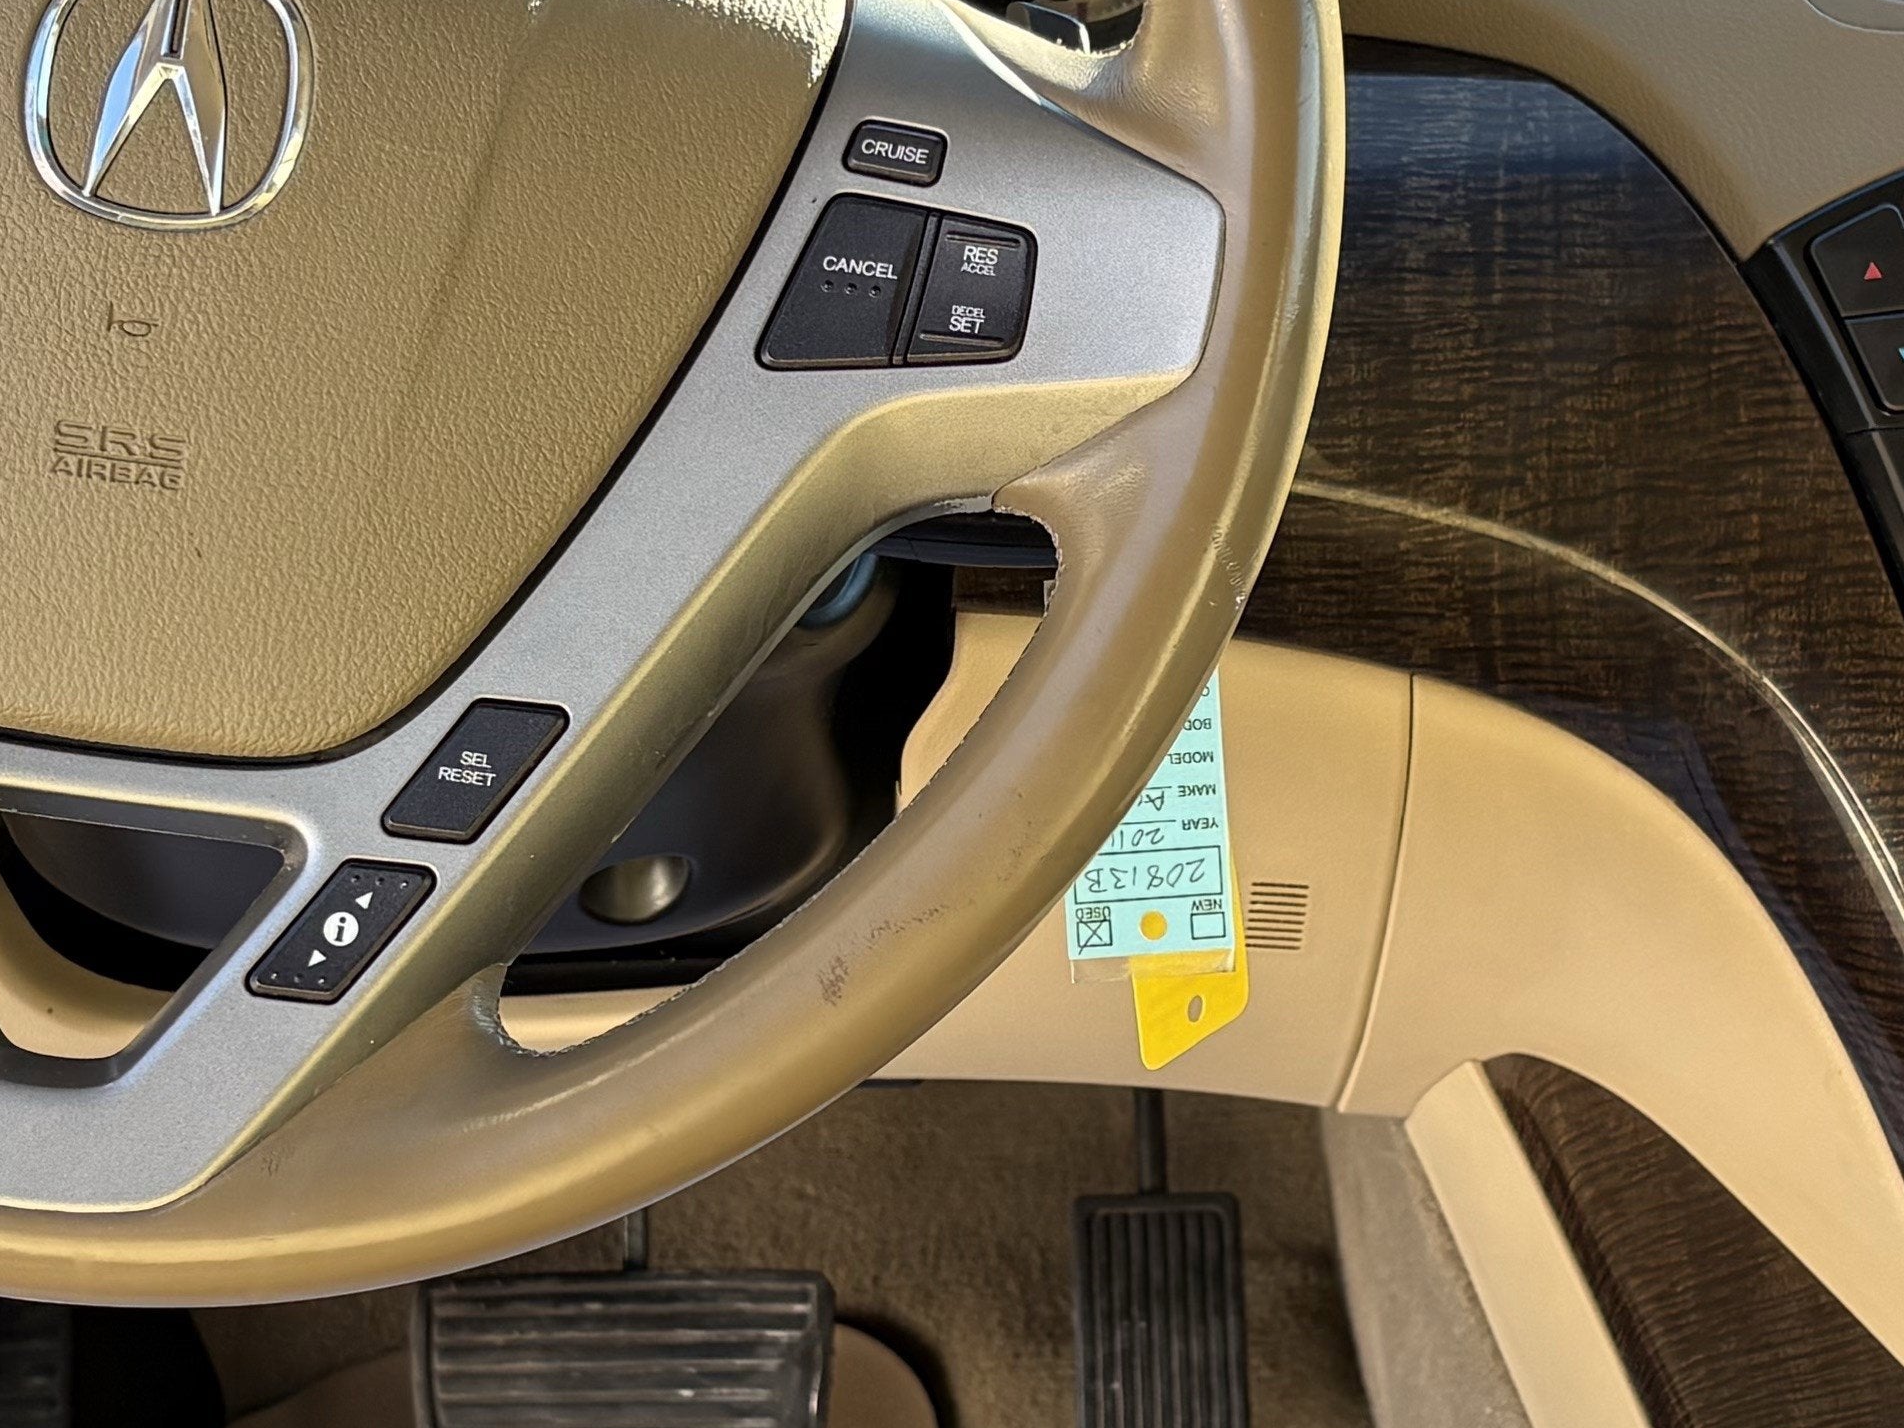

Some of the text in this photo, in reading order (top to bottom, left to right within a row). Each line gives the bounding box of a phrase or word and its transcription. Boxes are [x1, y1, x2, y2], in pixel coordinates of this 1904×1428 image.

[861, 139, 929, 165] CRUISE
[963, 245, 999, 265] RES
[823, 255, 898, 280] CANCEL
[960, 263, 996, 277] ACCEL
[951, 305, 986, 320] DECEL
[949, 316, 984, 334] SET
[54, 420, 187, 462] SRS
[50, 456, 183, 490] AIRBAG
[1183, 717, 1212, 730] BOD
[460, 751, 492, 769] SEL
[1167, 751, 1214, 764] MODEL
[438, 766, 496, 787] RESET
[1178, 784, 1216, 797] MAKE
[1181, 817, 1219, 830] YEAR
[1075, 906, 1111, 922] USED
[1191, 899, 1223, 912] NEW
